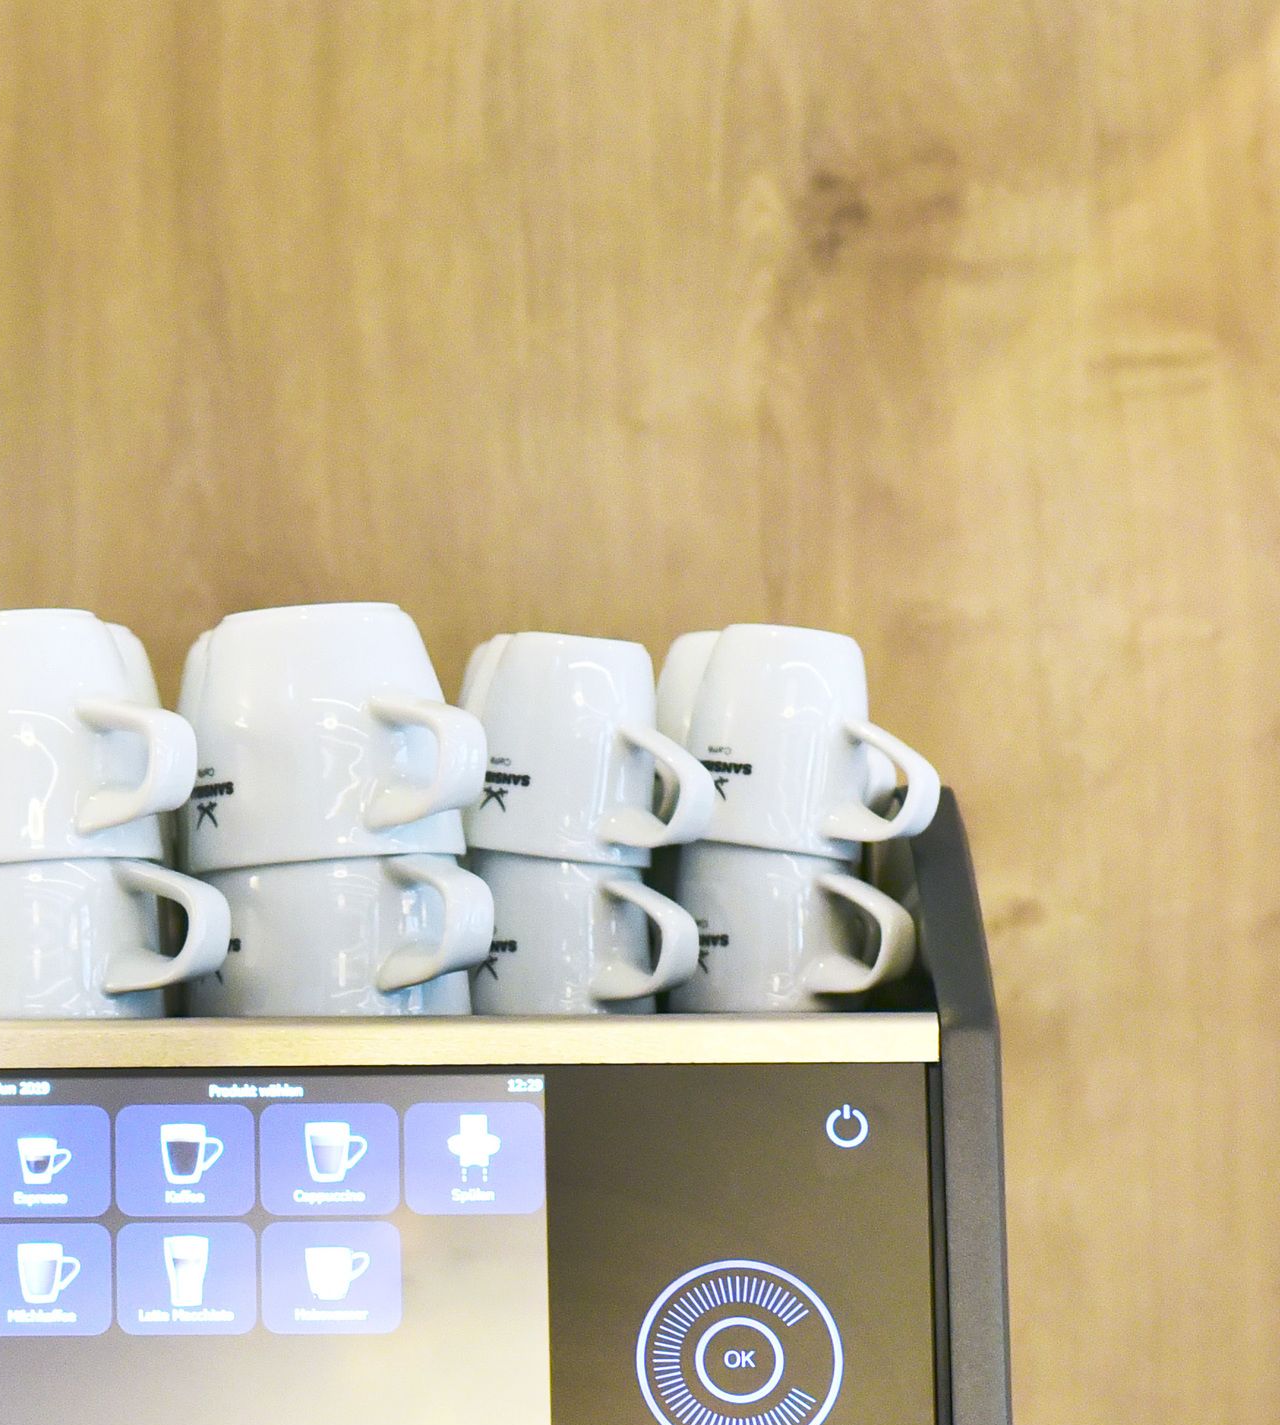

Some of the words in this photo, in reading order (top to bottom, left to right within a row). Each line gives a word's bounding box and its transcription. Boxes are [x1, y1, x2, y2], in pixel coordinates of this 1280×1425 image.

[208, 1083, 258, 1098] Produkt
[258, 1083, 304, 1098] wählen
[13, 1191, 68, 1206] Espresso
[165, 1190, 205, 1204] Kaffee
[293, 1189, 366, 1204] Cappuccino
[451, 1188, 496, 1203] Spülen
[7, 1309, 77, 1323] Milchkaffee
[138, 1309, 170, 1322] Latte
[172, 1309, 235, 1322] Macchiato
[724, 1350, 756, 1369] OK
